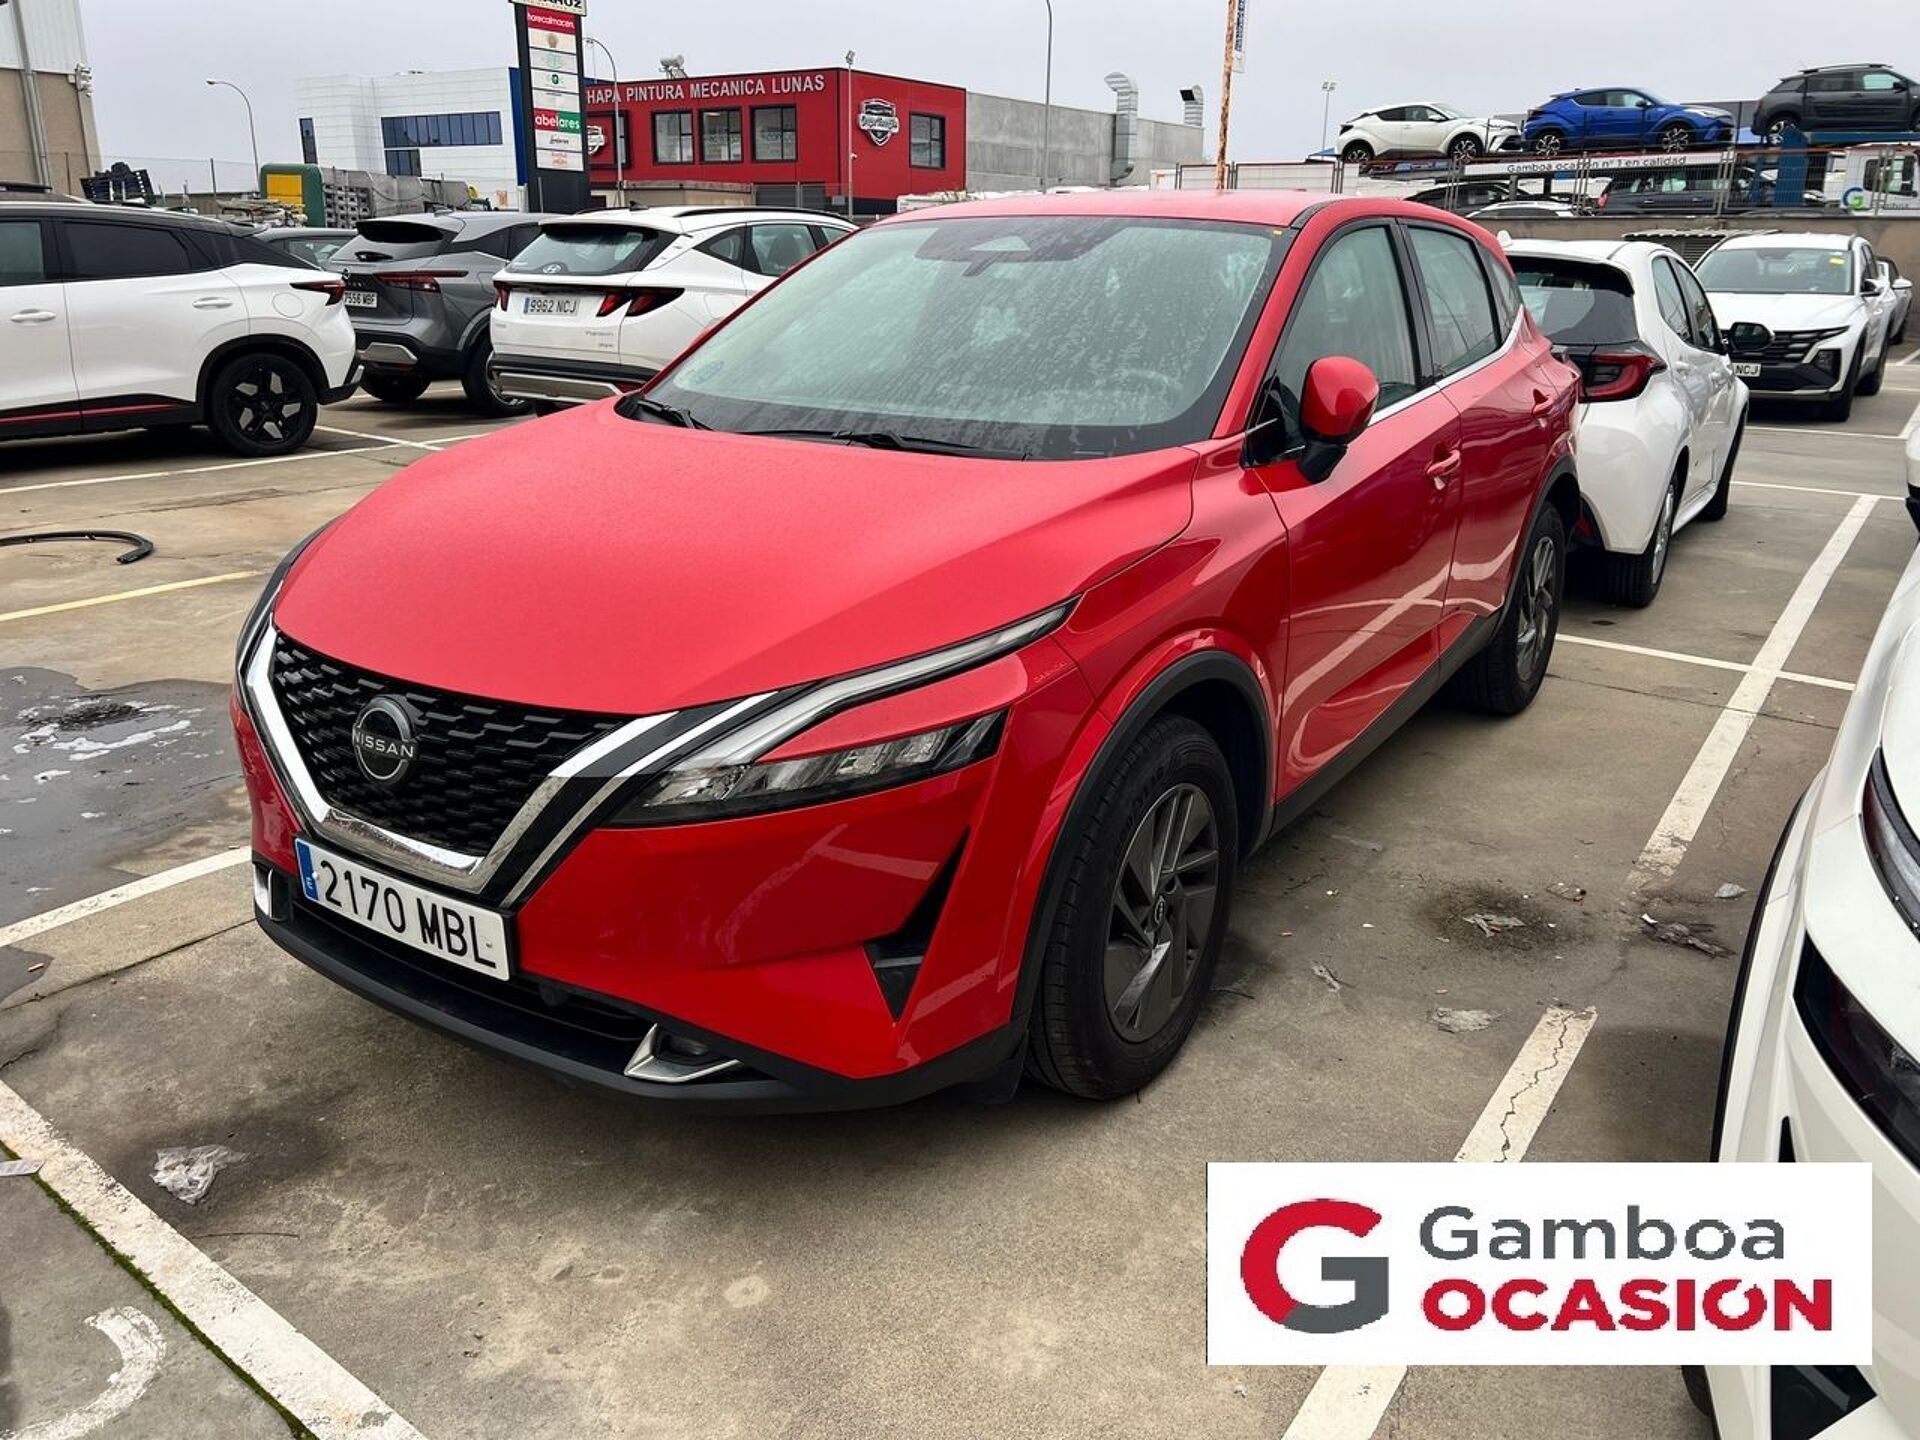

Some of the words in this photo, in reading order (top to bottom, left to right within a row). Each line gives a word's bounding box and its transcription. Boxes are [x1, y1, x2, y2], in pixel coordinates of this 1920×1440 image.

[626, 84, 684, 102] PINTURA
[690, 79, 765, 99] MECANICA
[772, 74, 825, 94] LUNAS
[535, 113, 580, 130] abelares
[1507, 162, 1552, 173] Gamboa
[1625, 157, 1640, 167] en
[1644, 155, 1688, 166] calidad
[530, 299, 553, 313] 9962
[555, 301, 577, 314] NCJ
[1735, 364, 1759, 376] NCJ
[352, 722, 414, 758] NISSAN
[320, 860, 406, 934] 2170
[416, 897, 497, 970] MBL
